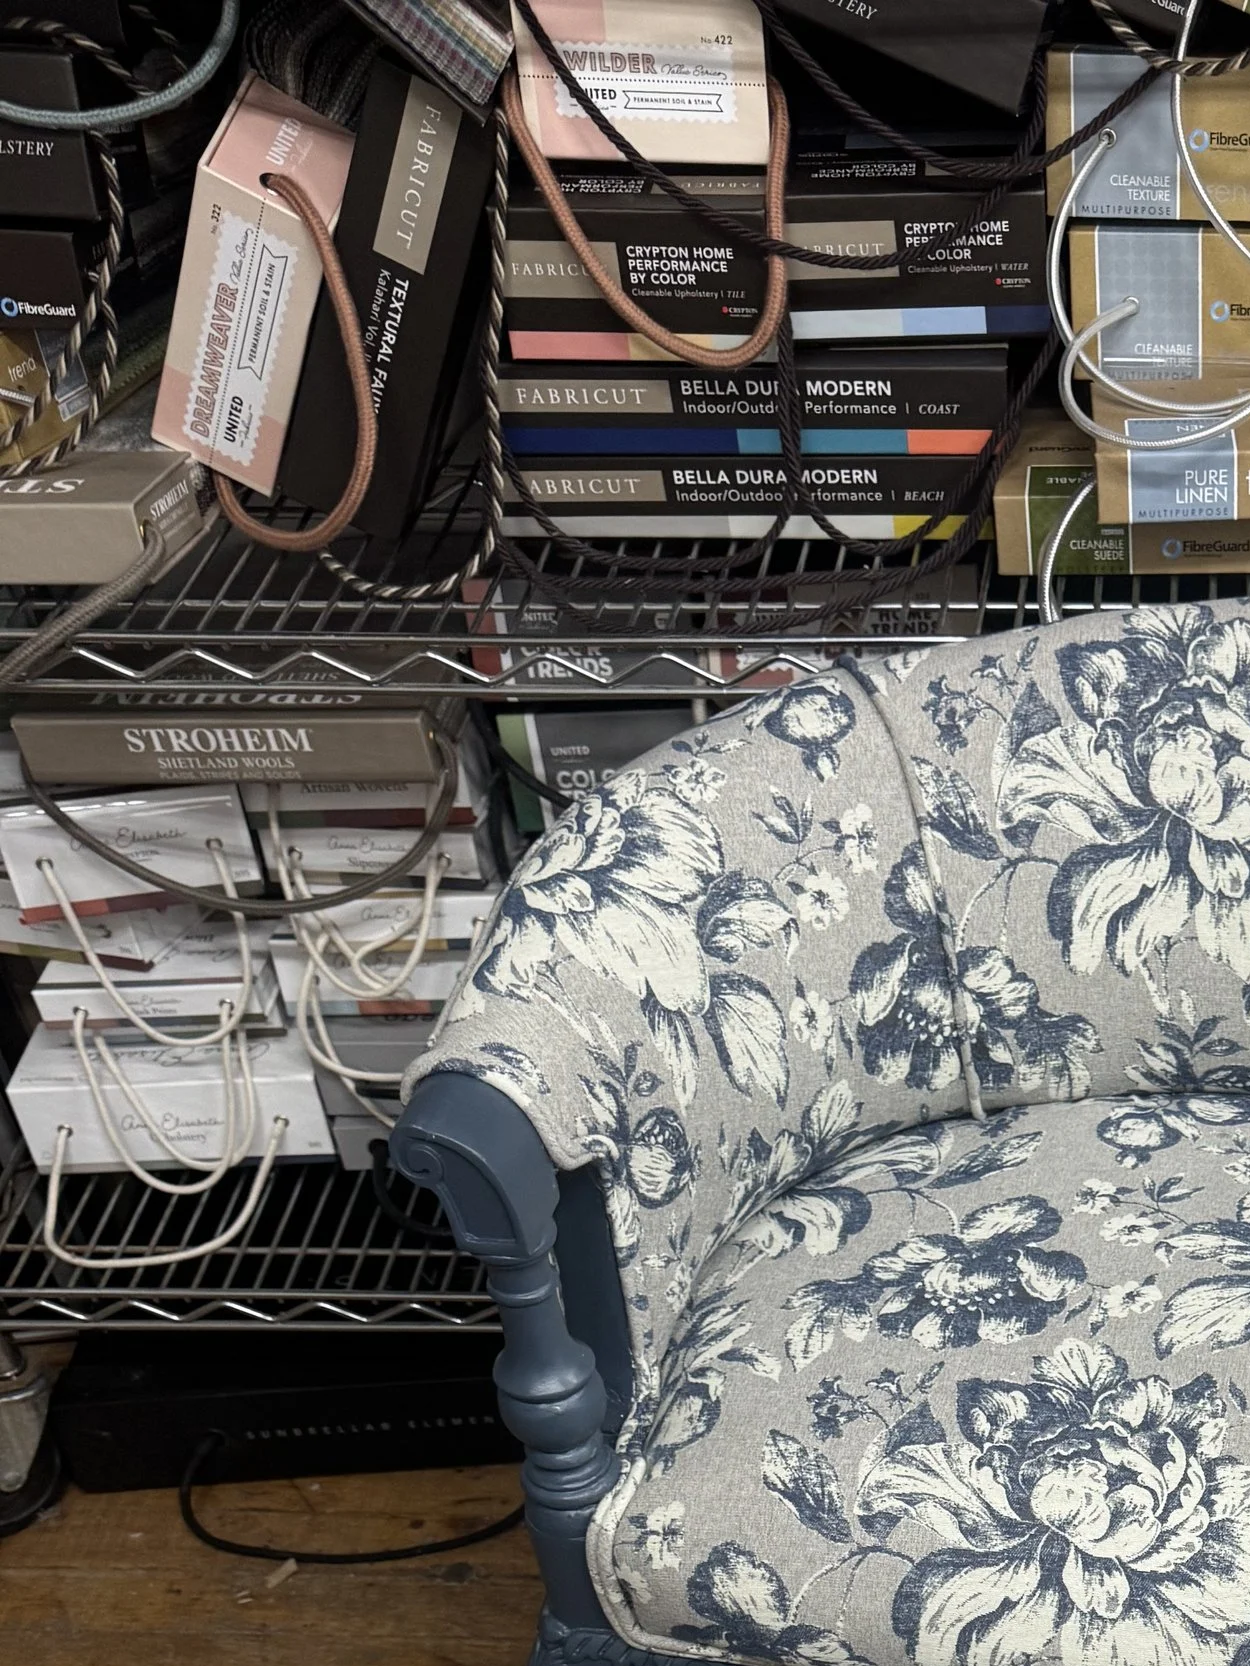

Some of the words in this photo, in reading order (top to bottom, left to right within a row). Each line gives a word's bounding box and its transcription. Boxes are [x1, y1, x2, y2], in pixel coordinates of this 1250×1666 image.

[714, 35, 733, 45] 422
[563, 50, 658, 75] WILDER
[633, 96, 671, 105] PERMANENT
[672, 97, 687, 105] SOIL
[694, 98, 713, 106] STAIN
[265, 117, 302, 166] UNITED
[396, 103, 442, 249] FABRICUT
[1109, 173, 1170, 188] CLEANABLE
[1126, 187, 1171, 202] TEXTURE
[212, 203, 223, 223] 322
[1081, 203, 1172, 217] MULTIPURPOSE
[626, 246, 689, 259] CRYPTON
[692, 247, 734, 260] HOME
[628, 259, 728, 273] PERFORMANCE
[949, 263, 993, 276] Upholstery
[1001, 262, 1030, 272] WATER
[630, 273, 646, 285] BY
[650, 273, 697, 286] COLOR
[369, 268, 392, 322] Kalahari
[631, 288, 672, 298] Cleanable
[674, 288, 719, 299] Upholstery
[727, 290, 746, 299] TILE
[18, 301, 76, 317] FibreGuard
[247, 315, 267, 364] PERMANENT
[258, 295, 269, 316] SOIL
[265, 262, 276, 289] STAIN
[377, 279, 410, 363] TEXTURAL
[1134, 343, 1194, 356] CLEANABLE
[190, 282, 239, 438] DREAMWEAVER
[516, 387, 648, 405] FABRICUT
[680, 380, 739, 396] BELLA
[805, 380, 892, 397] MODERN
[804, 400, 897, 415] Performance
[918, 403, 960, 415] COAST
[223, 395, 244, 444] UNITED
[530, 478, 641, 495] ABRICUT
[672, 469, 731, 485] BELLA
[735, 469, 788, 485] DURA
[1184, 469, 1229, 486] PURE
[675, 489, 785, 502] Indoor/Outdoo
[904, 490, 944, 501] BEACH
[1175, 486, 1229, 505] LINEN
[1137, 506, 1229, 518] MULTIPURPOSE
[1069, 539, 1125, 550] CLEANABLE
[1183, 539, 1250, 553] FibreGuard
[1094, 549, 1125, 561] SUEDE
[123, 728, 310, 753] STROHEIM
[551, 746, 590, 757] UNITED
[157, 756, 238, 770] SHETLAND
[242, 756, 296, 770] WOOLS
[406, 1414, 496, 1429] ELEMEN
